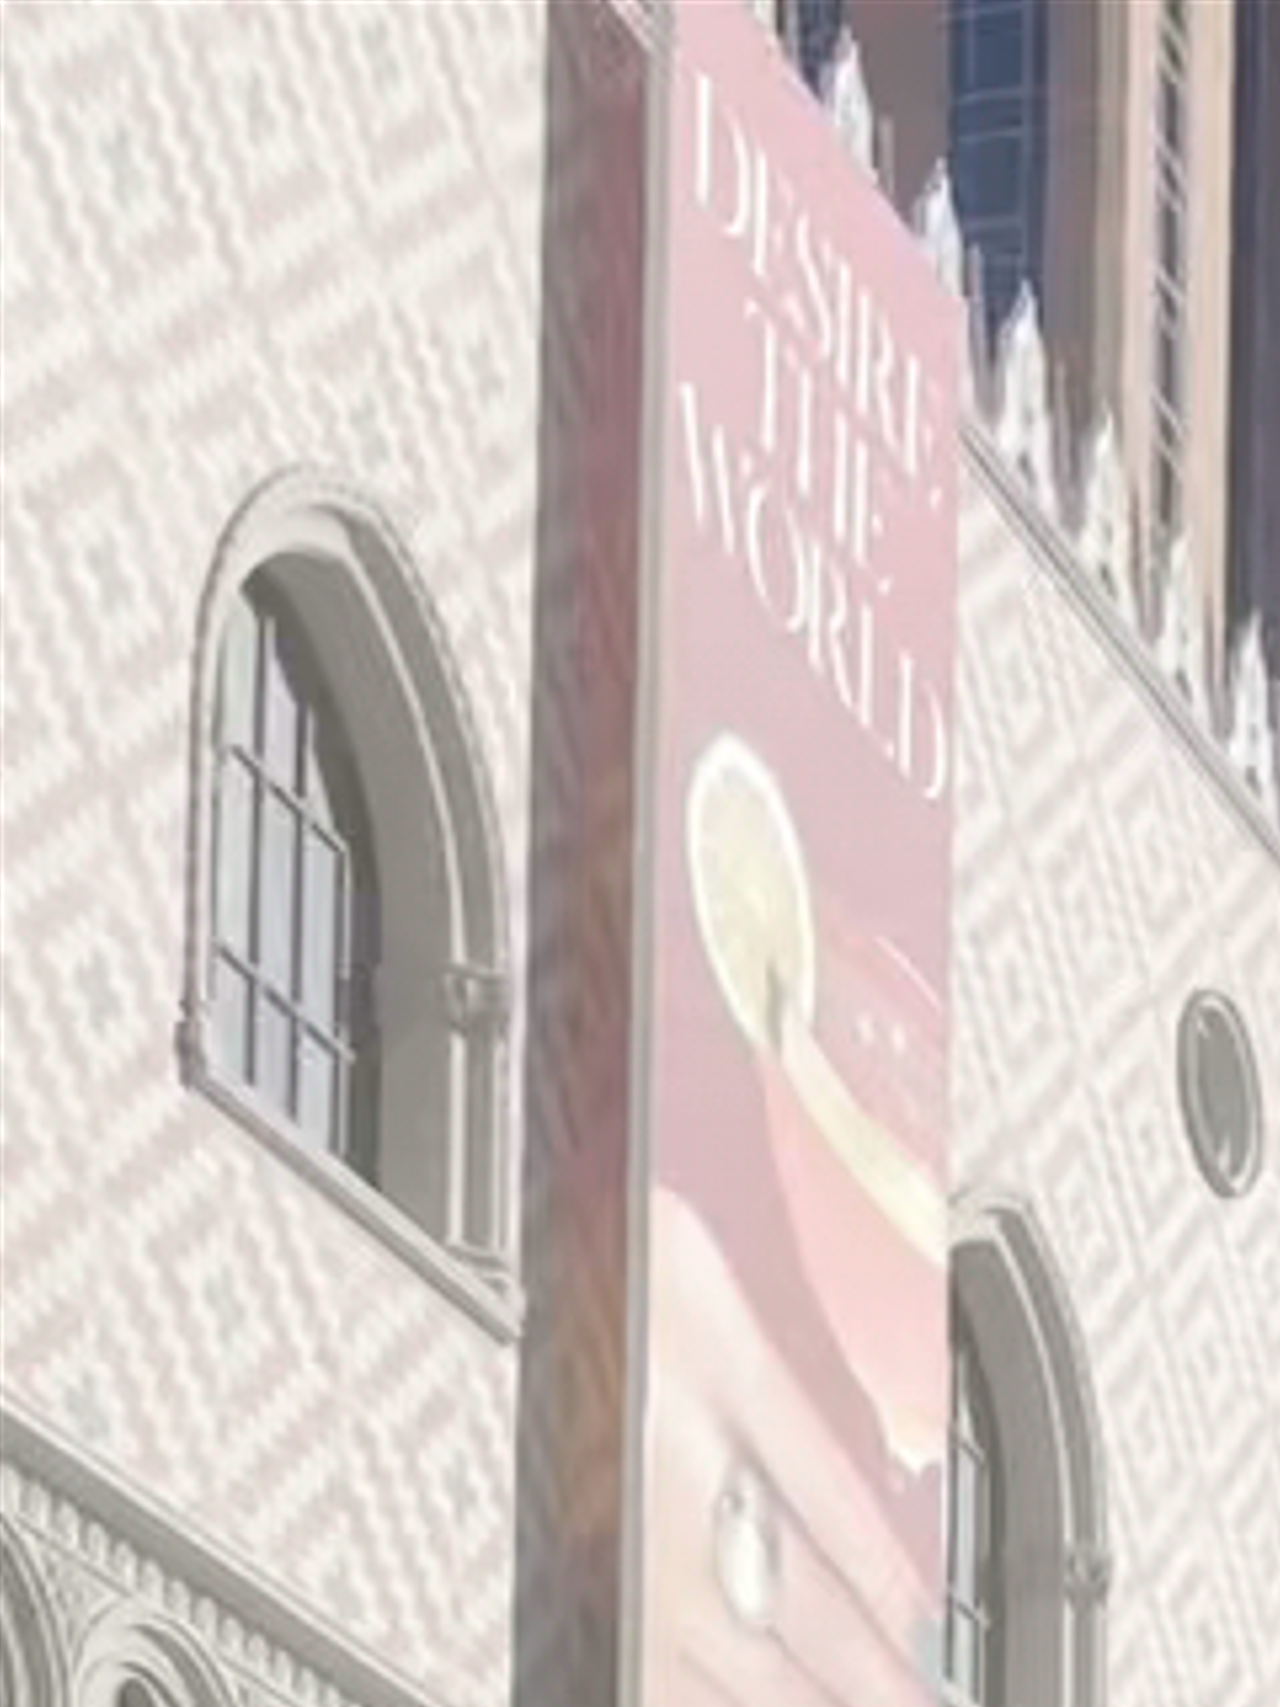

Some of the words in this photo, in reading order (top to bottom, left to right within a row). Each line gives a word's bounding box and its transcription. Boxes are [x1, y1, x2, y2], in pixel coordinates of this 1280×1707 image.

[690, 70, 943, 511] DESIRE
[742, 294, 894, 596] THE
[678, 379, 945, 801] WORLD
